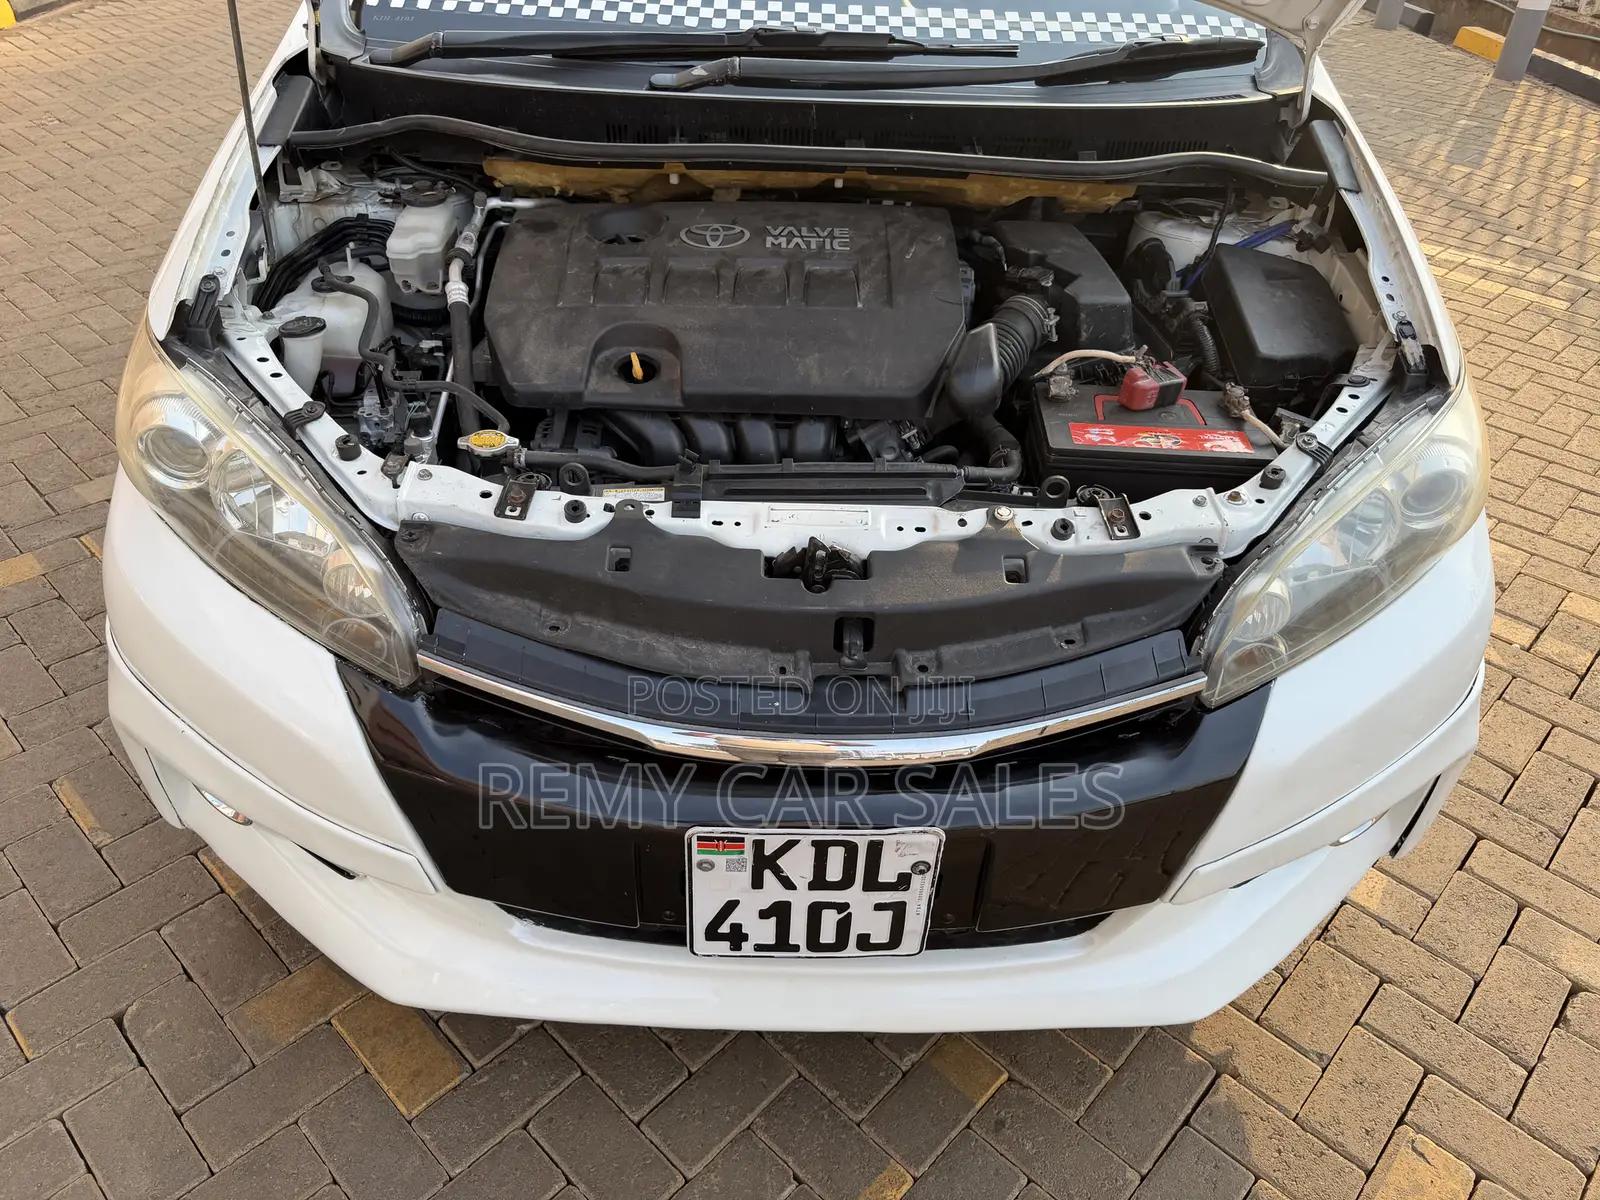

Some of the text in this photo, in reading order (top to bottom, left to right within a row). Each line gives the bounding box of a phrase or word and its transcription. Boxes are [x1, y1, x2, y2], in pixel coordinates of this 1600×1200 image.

[765, 225, 850, 238] VALVE
[765, 237, 851, 251] MATIC
[750, 839, 913, 892] KDL
[704, 899, 908, 952] 410J
